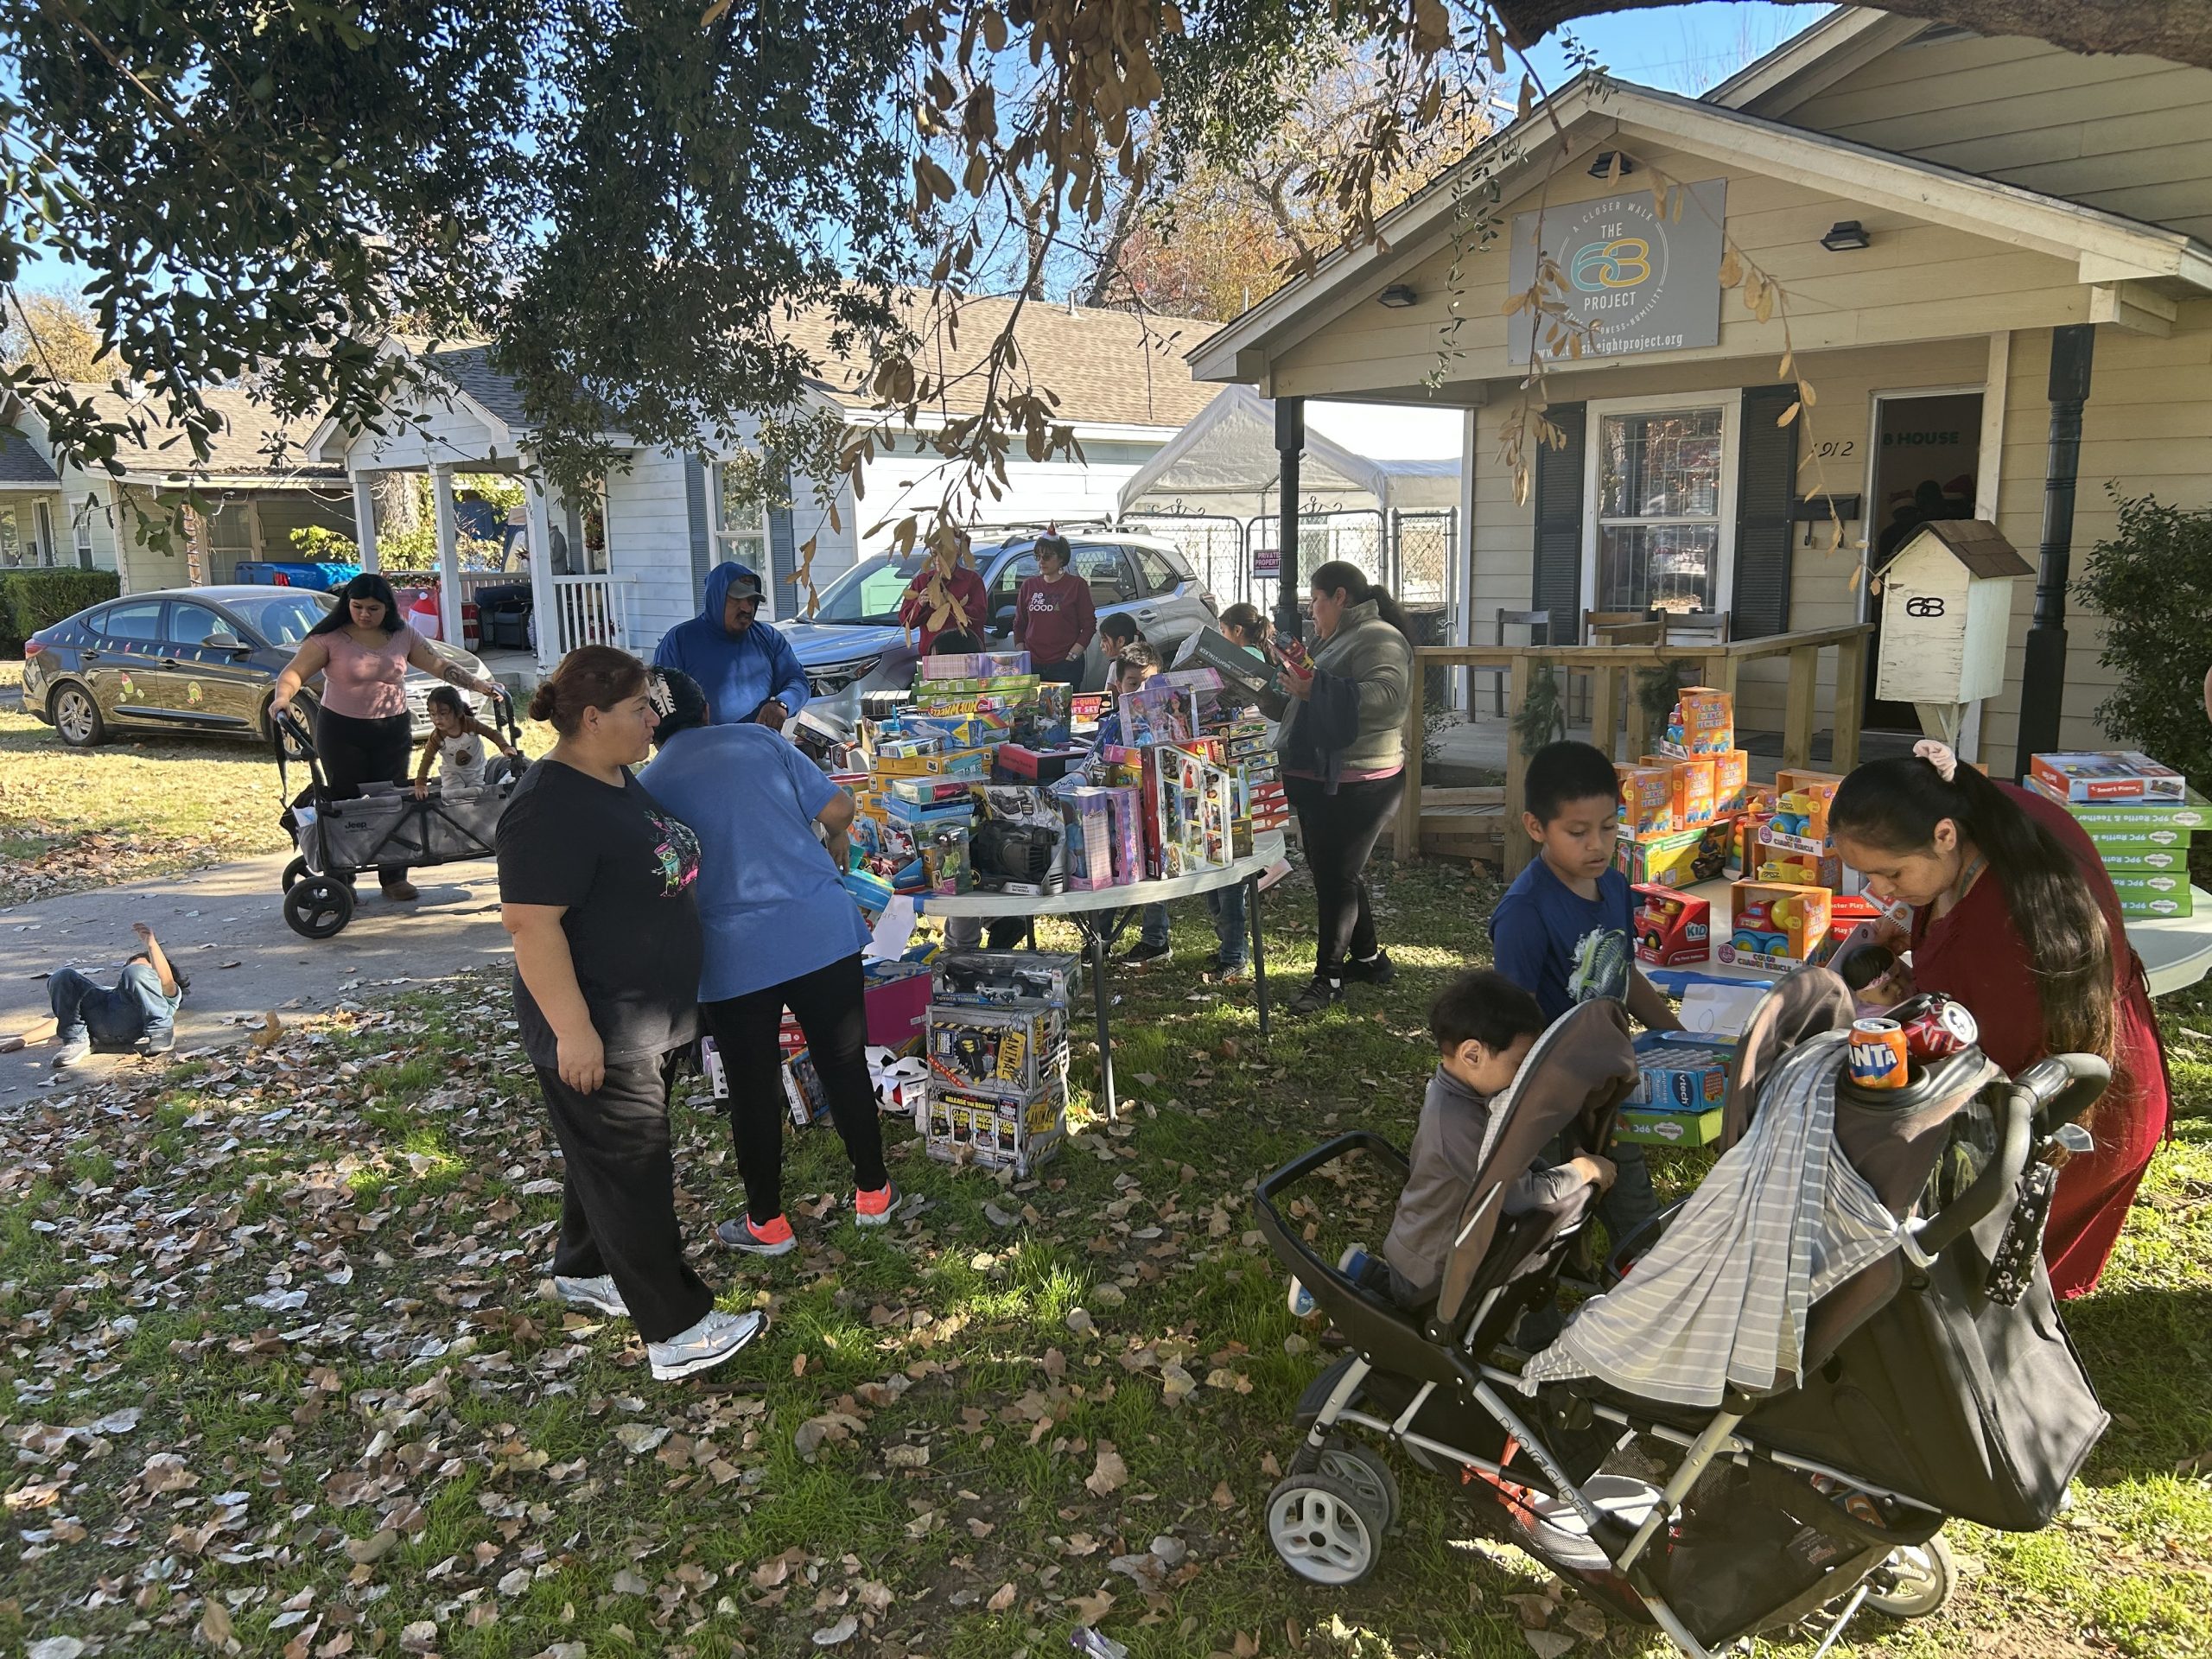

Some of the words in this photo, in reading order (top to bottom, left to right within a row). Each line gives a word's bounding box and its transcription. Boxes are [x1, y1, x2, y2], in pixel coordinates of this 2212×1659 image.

[1583, 201, 1621, 222] CLOSER
[1628, 202, 1654, 221] WALK
[1601, 222, 1623, 238] THE
[1584, 291, 1637, 311] PROJECT
[1630, 287, 1664, 325] HUMILITY
[1897, 432, 1959, 445] HOUSE
[1198, 647, 1231, 670] NIGHTSTALKER
[1699, 703, 1723, 712] COLOR
[1774, 839, 1793, 849] CHANGE
[1794, 843, 1814, 852] VEHICLE
[1785, 835, 1802, 843] COLOR
[1687, 925, 1707, 937] KID
[1738, 958, 1764, 968] CHANGE
[1764, 963, 1791, 971] VEHICLE
[1753, 953, 1776, 963] COLOR
[1001, 1036, 1020, 1076] ANIMAL
[1679, 1073, 1688, 1104] vtech
[945, 1096, 966, 1106] RELEASE
[976, 1102, 995, 1111] BEAST?
[1633, 1123, 1650, 1133] 9PC
[1498, 1416, 1529, 1450] DUO
[1544, 1468, 1589, 1516] GLIDER
